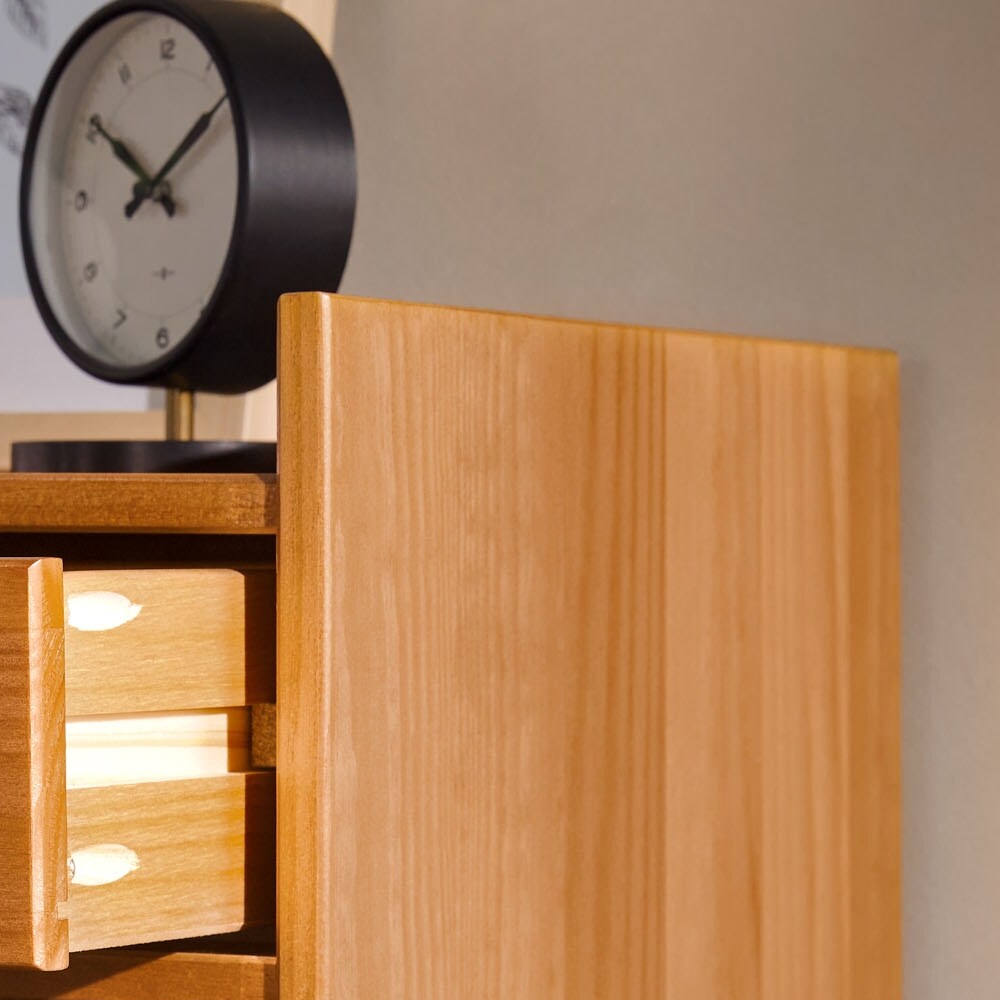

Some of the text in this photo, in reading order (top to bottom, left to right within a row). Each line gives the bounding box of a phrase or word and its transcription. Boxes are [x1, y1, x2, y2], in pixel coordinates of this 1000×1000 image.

[160, 38, 175, 60] 12
[118, 62, 132, 86] 11
[112, 307, 127, 329] 7
[155, 327, 169, 349] 6
